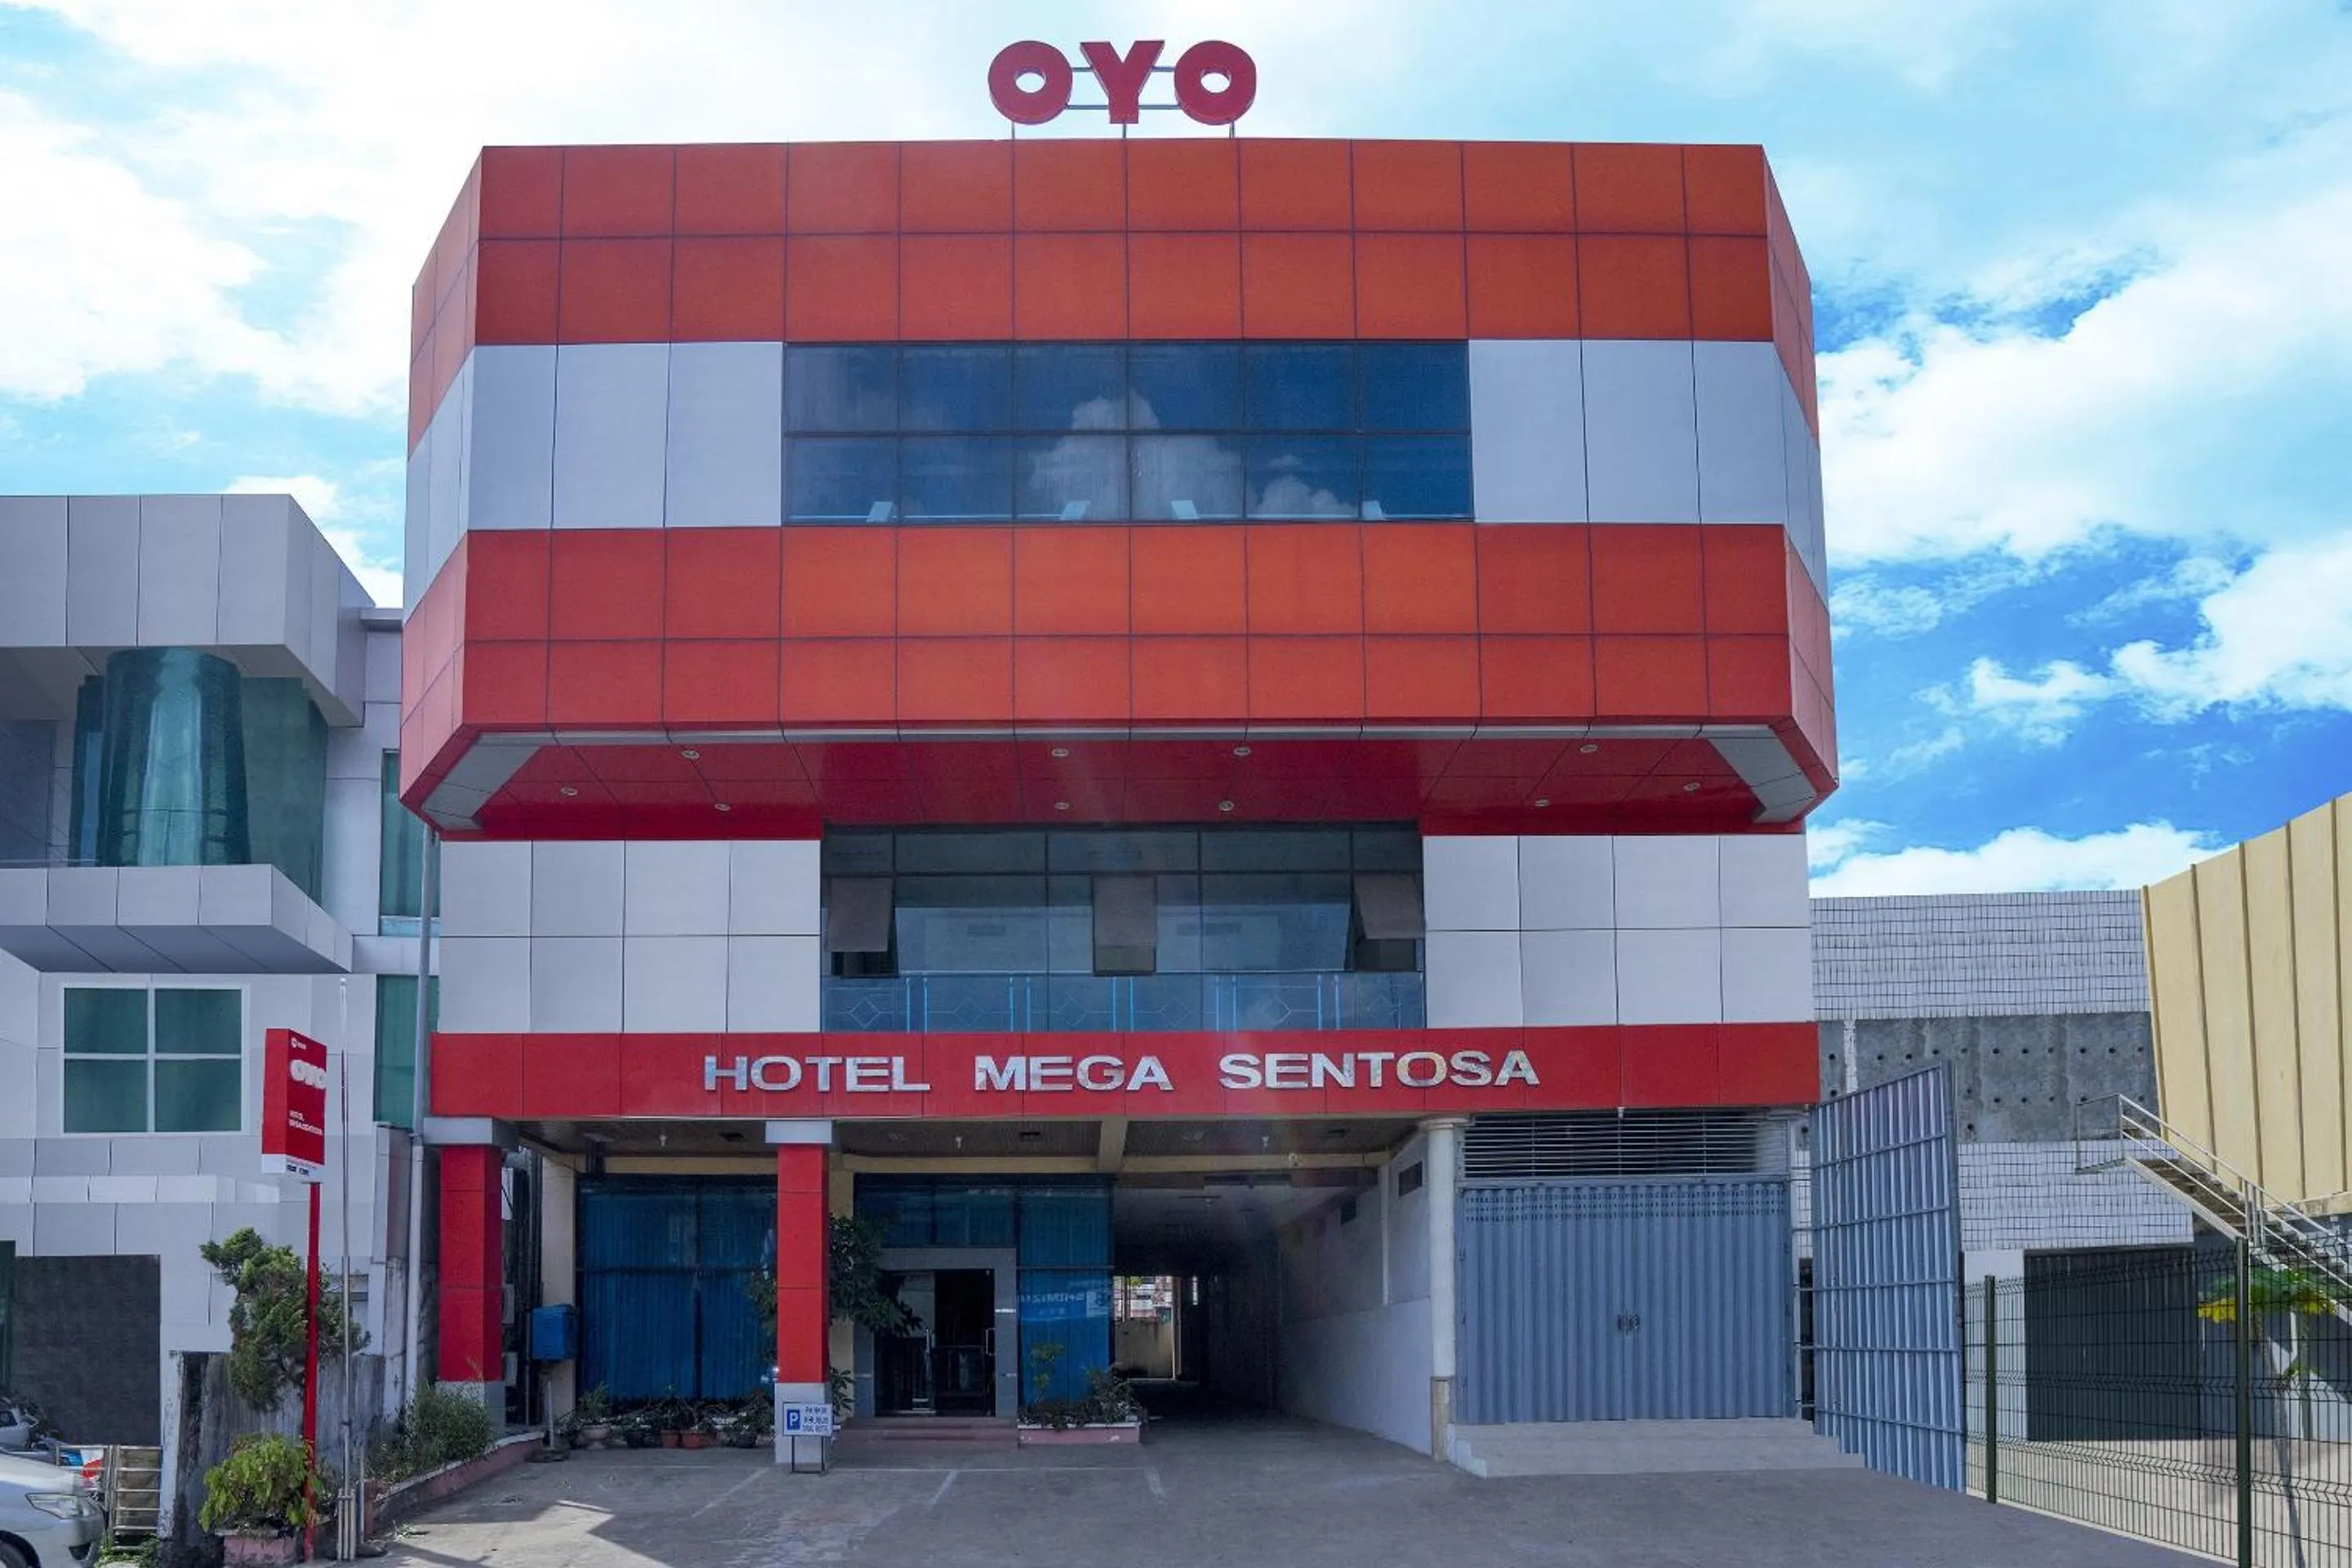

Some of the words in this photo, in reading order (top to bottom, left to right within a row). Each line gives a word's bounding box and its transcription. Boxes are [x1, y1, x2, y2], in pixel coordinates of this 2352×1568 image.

[988, 39, 1257, 125] OYO
[290, 1059, 327, 1089] OYO
[704, 1055, 931, 1092] HOTEL
[974, 1055, 1174, 1092] MEGA
[1219, 1049, 1540, 1089] SENTOSA
[790, 1412, 799, 1427] P
